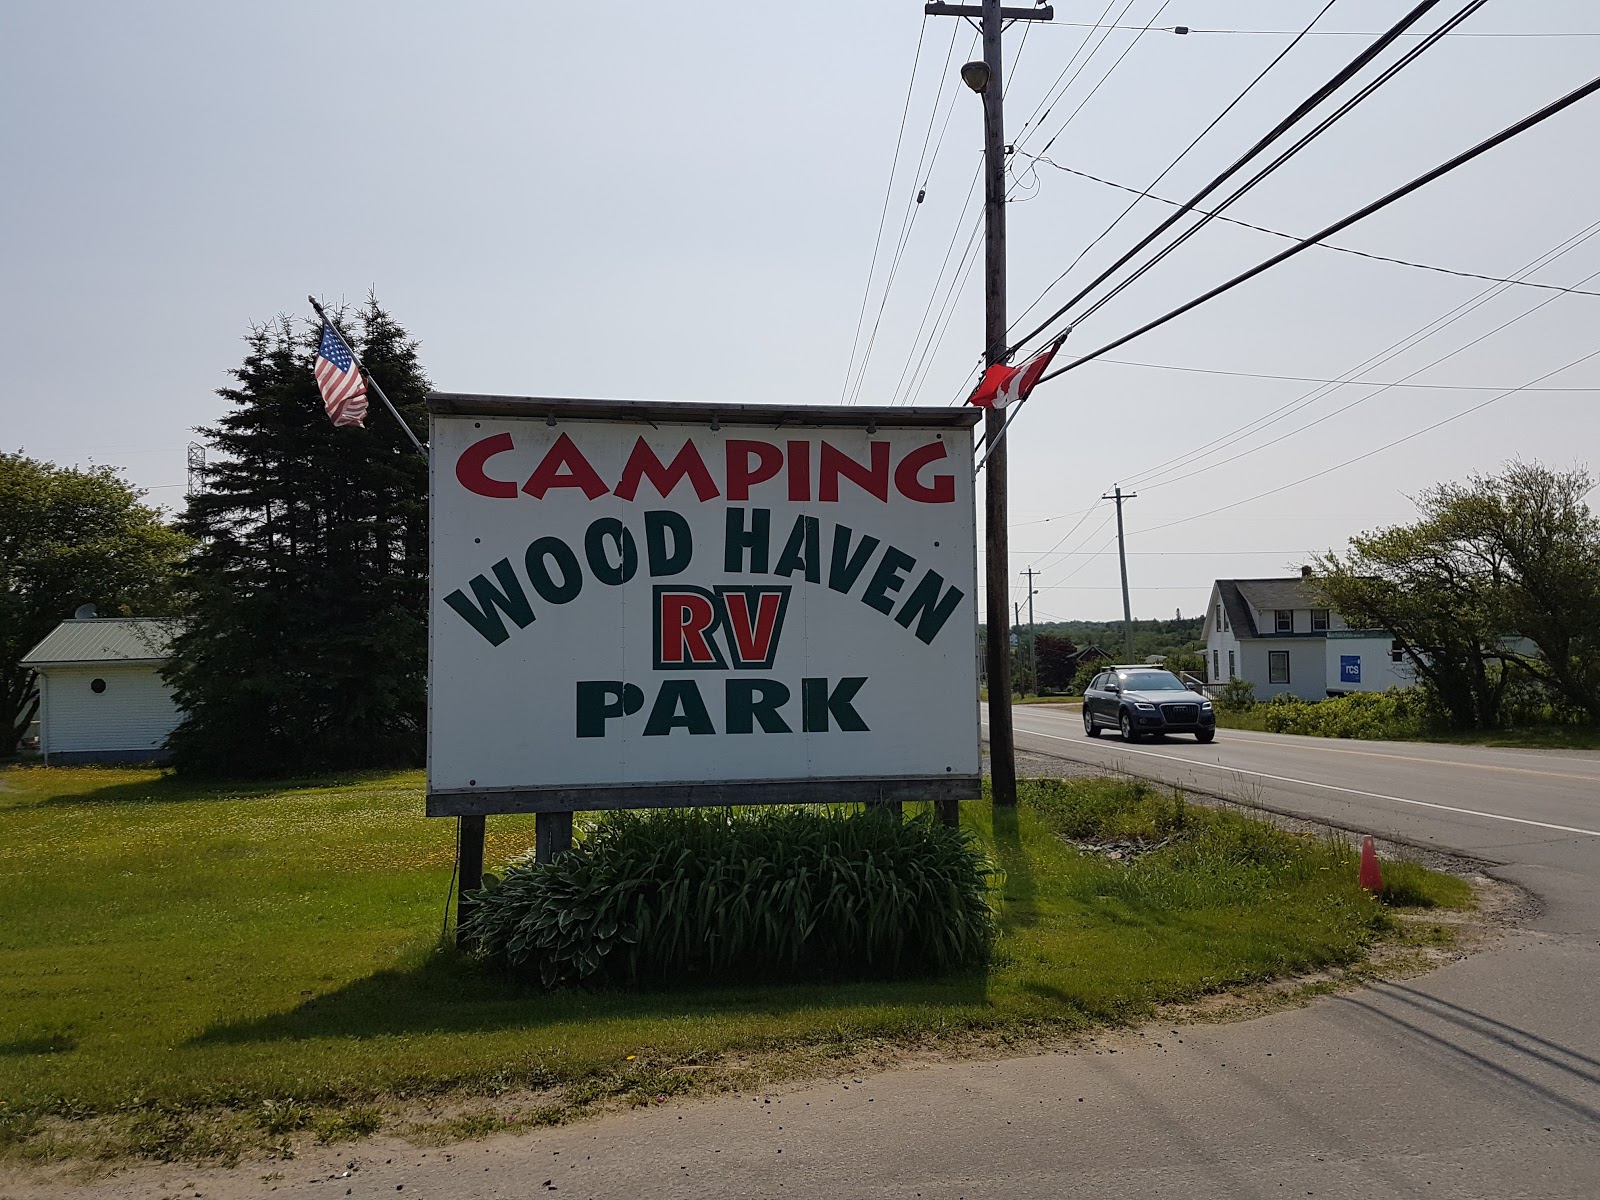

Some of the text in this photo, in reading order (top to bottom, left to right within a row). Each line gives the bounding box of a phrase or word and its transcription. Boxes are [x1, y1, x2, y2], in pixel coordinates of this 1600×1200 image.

[456, 432, 955, 503] CAMPING
[443, 507, 964, 647] WOOD HAVEN
[653, 585, 792, 669] RV
[576, 677, 870, 737] PARK
